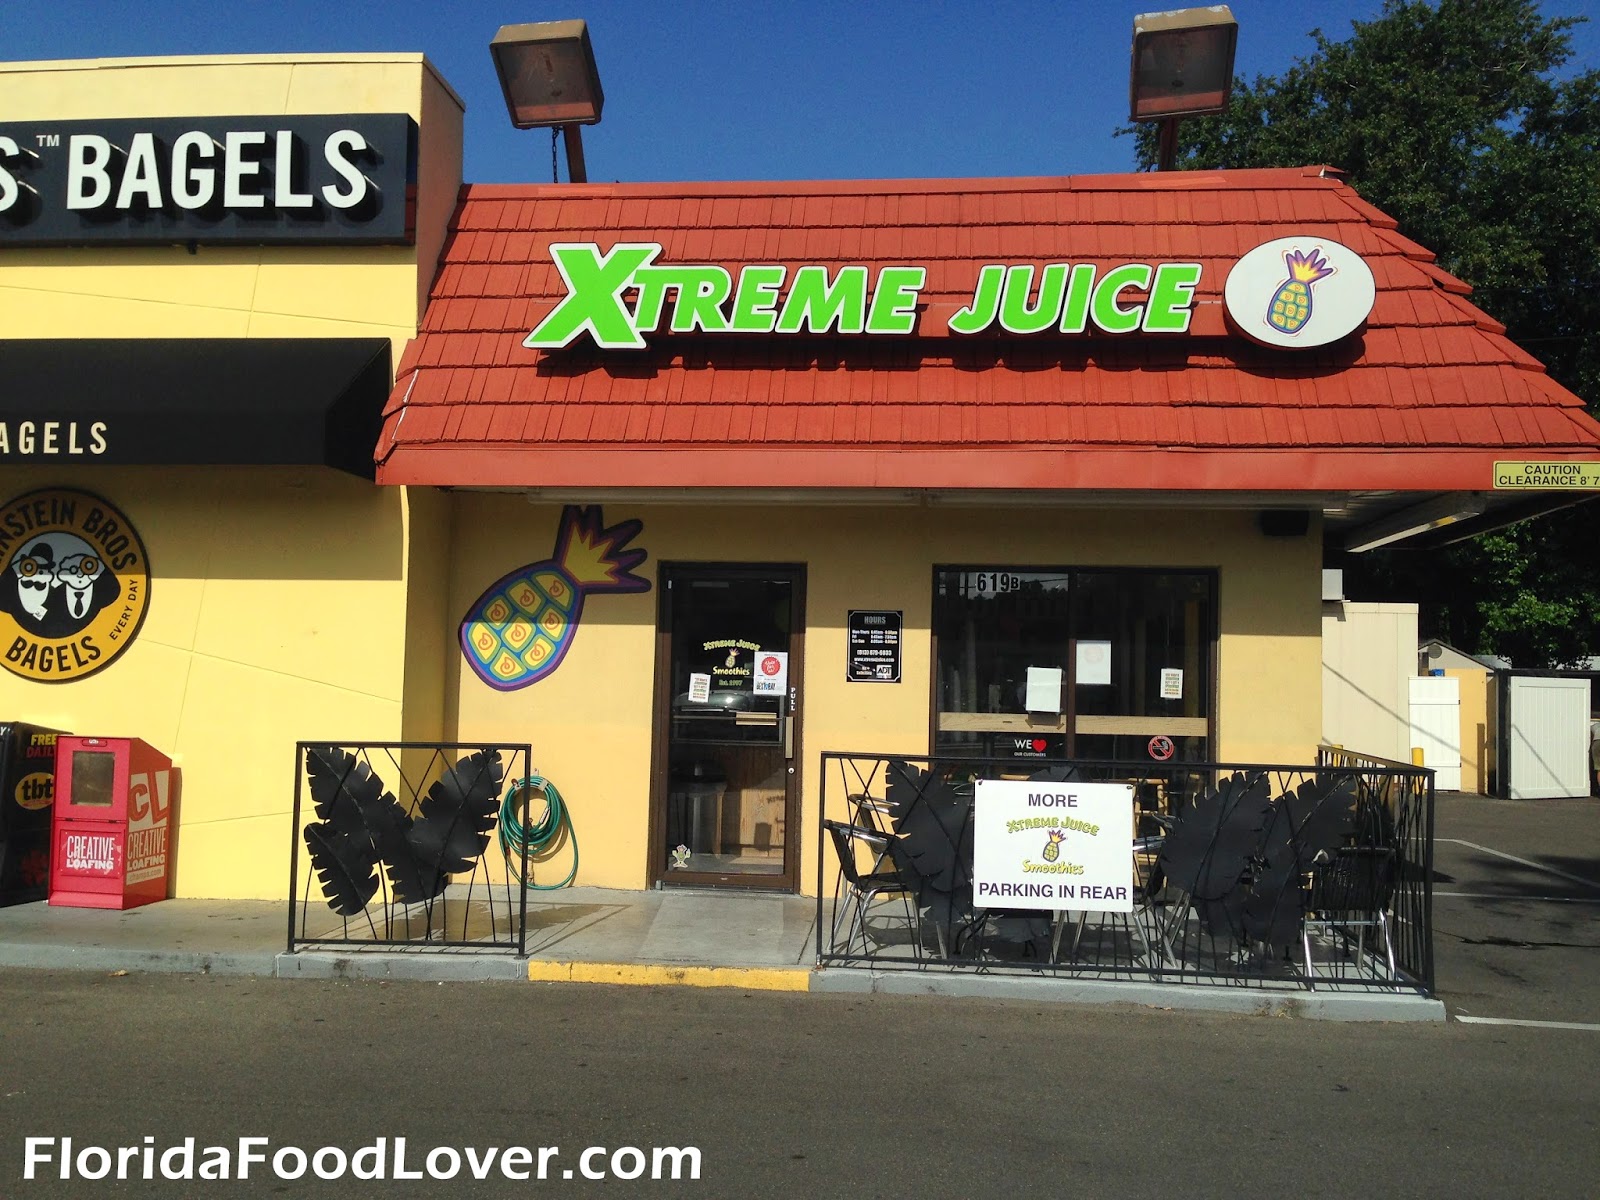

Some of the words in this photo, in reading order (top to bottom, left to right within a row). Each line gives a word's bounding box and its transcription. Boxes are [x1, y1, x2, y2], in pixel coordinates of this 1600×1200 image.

[36, 134, 60, 147] TM
[67, 129, 367, 210] BAGELS
[521, 242, 926, 349] XTREME
[948, 263, 1203, 334] JUICE
[1524, 465, 1581, 475] CAUTION
[1499, 476, 1577, 485] CLEARANCE
[82, 507, 138, 571] BROS
[109, 605, 134, 641] EVERY
[127, 579, 138, 601] DAY
[864, 616, 886, 624] HOURS
[5, 635, 101, 673] BAGELS
[712, 665, 750, 677] Smoothies
[31, 734, 57, 746] FREE
[1014, 739, 1032, 749] WE
[22, 778, 53, 800] tbt
[127, 772, 168, 825] CL
[1028, 793, 1078, 808] MORE
[1006, 816, 1060, 834] XTREME
[1061, 816, 1101, 837] JUICE
[66, 835, 115, 861] CREATIVE
[127, 827, 166, 860] CREATIVE
[66, 858, 114, 870] LOAFING
[126, 854, 165, 872] LOAFING
[1022, 858, 1085, 876] Smoothies
[979, 882, 1053, 898] PARKING
[1058, 885, 1075, 898] IN
[1080, 886, 1127, 900] REAR
